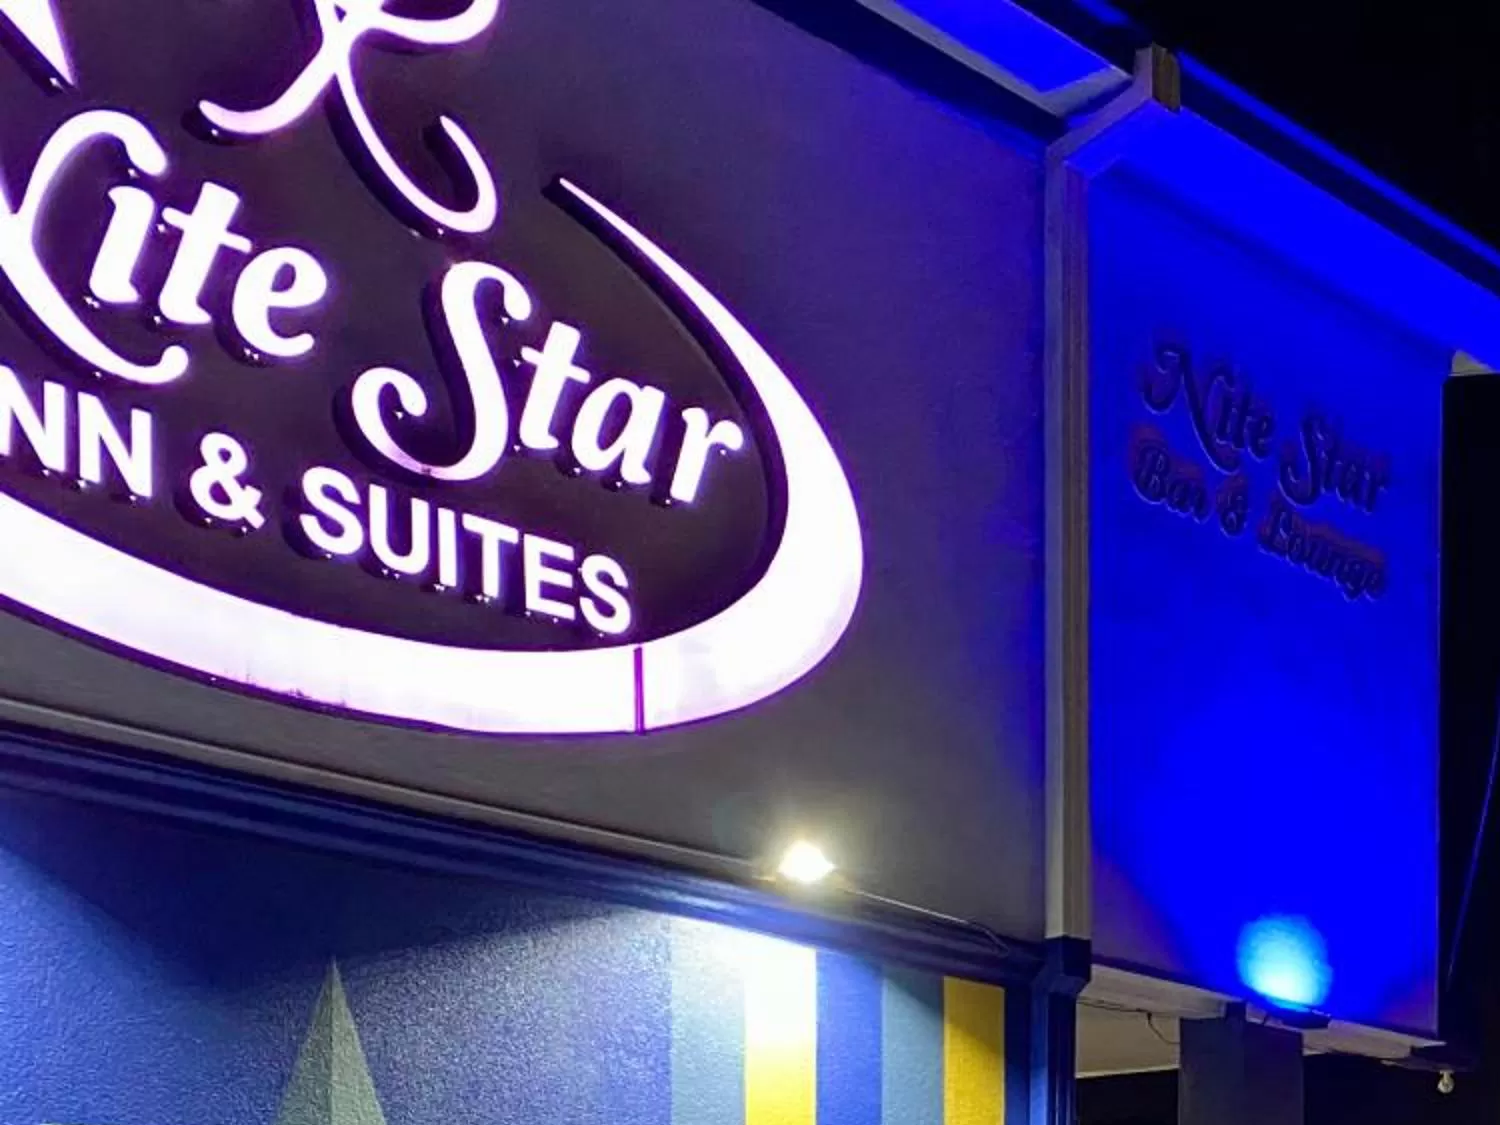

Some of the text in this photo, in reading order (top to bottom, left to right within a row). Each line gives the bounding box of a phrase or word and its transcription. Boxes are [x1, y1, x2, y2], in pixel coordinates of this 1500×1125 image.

[350, 261, 743, 504] Star
[1141, 345, 1388, 514] Nite Star
[189, 431, 266, 530] &
[299, 467, 633, 635] SUITES
